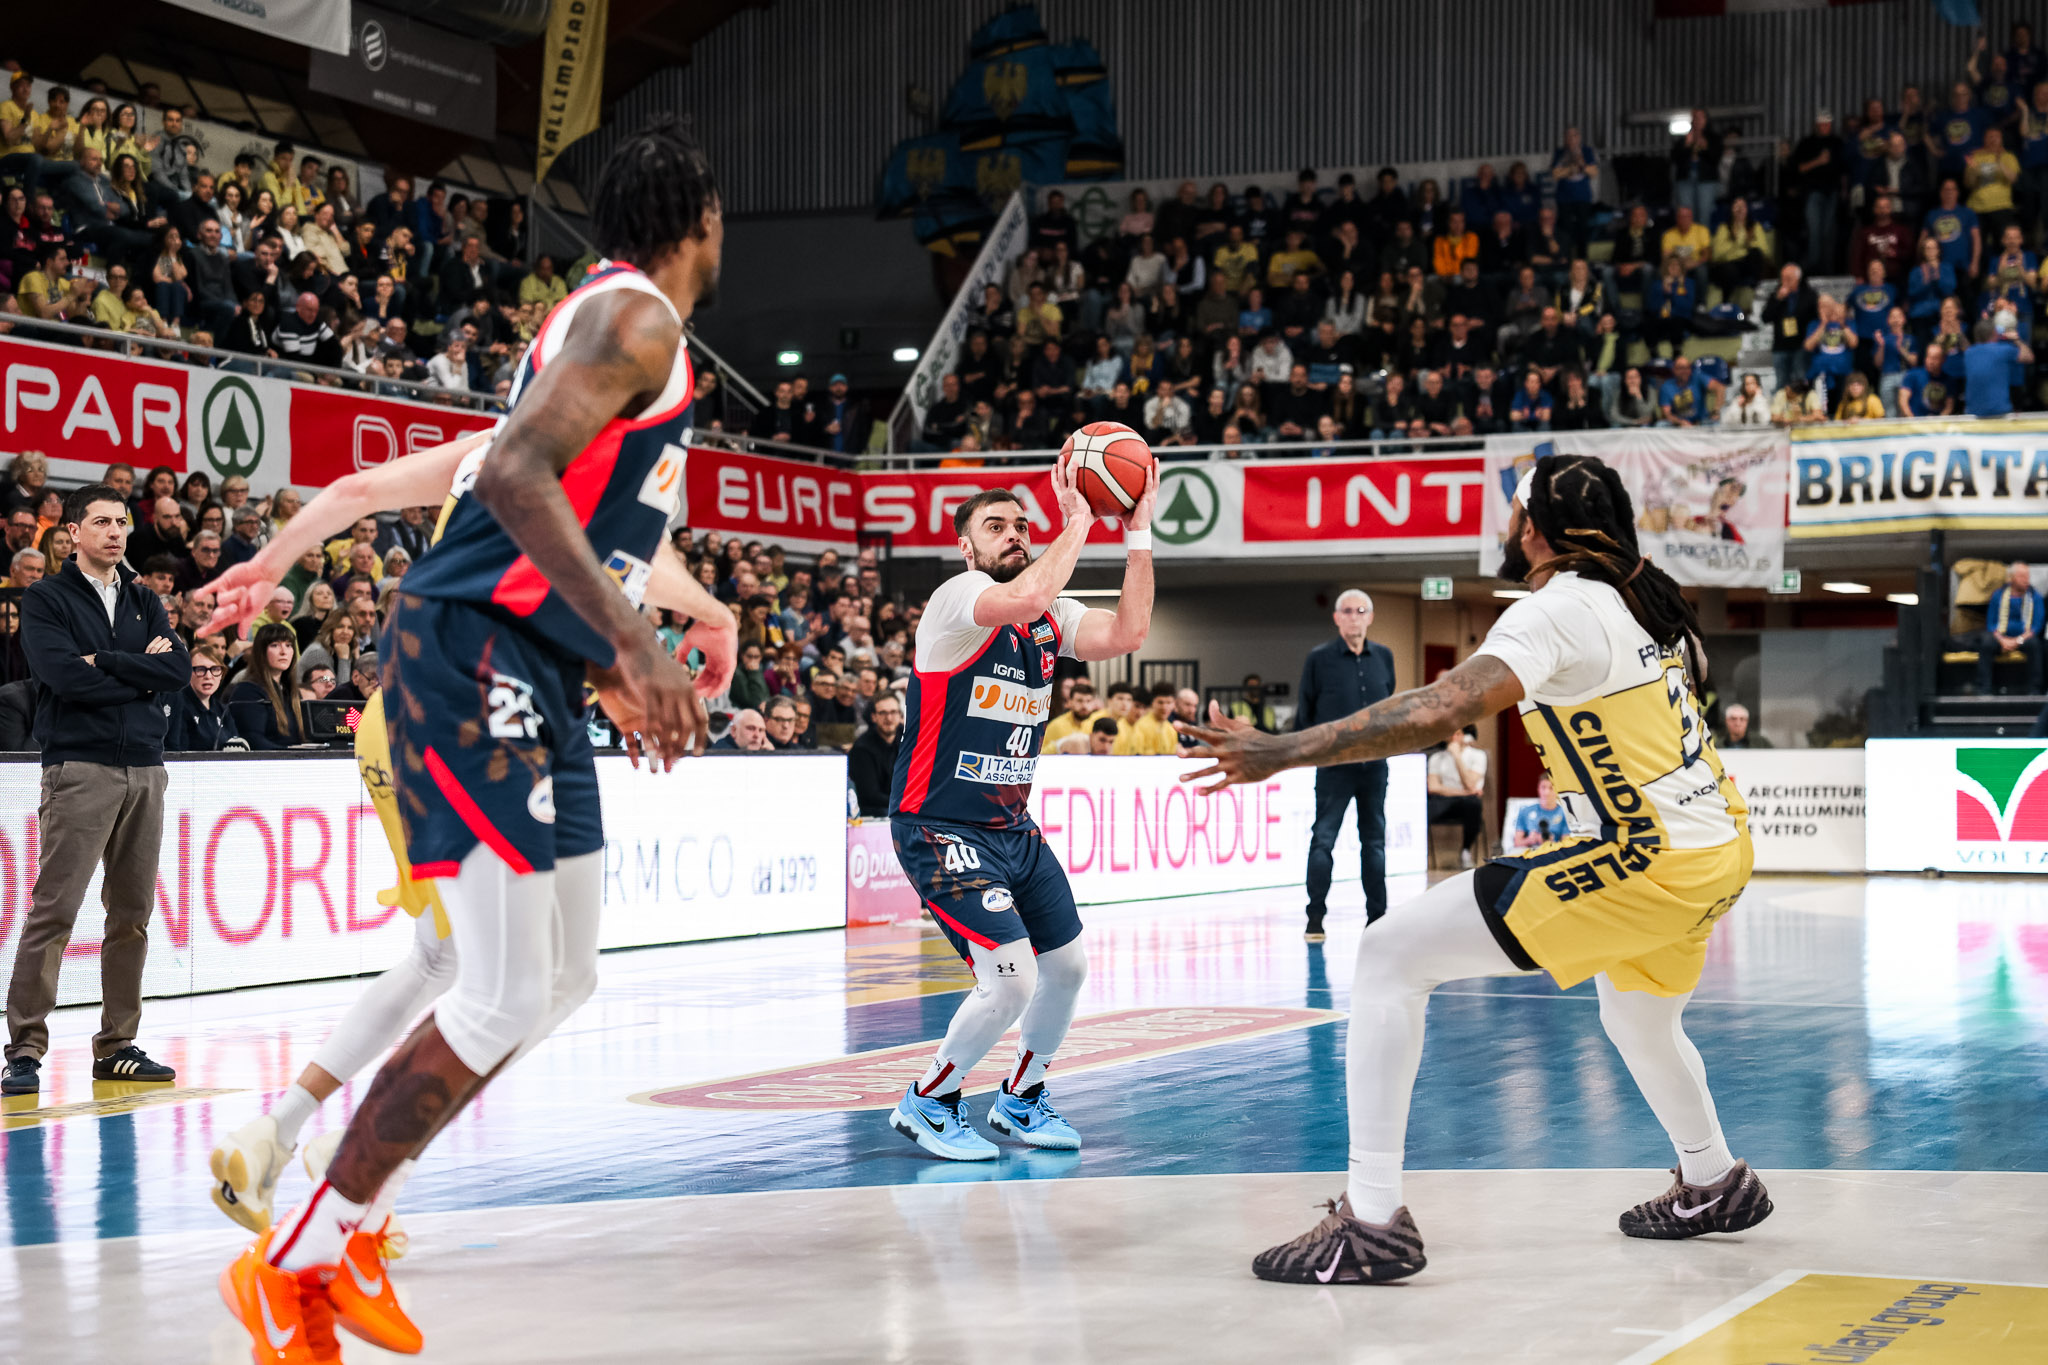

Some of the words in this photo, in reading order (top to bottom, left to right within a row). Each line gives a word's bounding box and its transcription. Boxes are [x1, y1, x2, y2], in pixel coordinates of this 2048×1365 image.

[5, 363, 182, 454] PAR
[1797, 449, 2048, 506] BRIGATA
[1306, 472, 1485, 529] INT
[993, 663, 1026, 681] IGNIS
[1006, 726, 1032, 756] 40
[1749, 785, 1866, 798] ARCHITETTUR
[1748, 805, 1766, 817] IN
[1762, 823, 1818, 837] VETRO
[780, 855, 818, 893] 1979
[945, 843, 981, 874] 40
[1870, 1283, 1981, 1326] group
